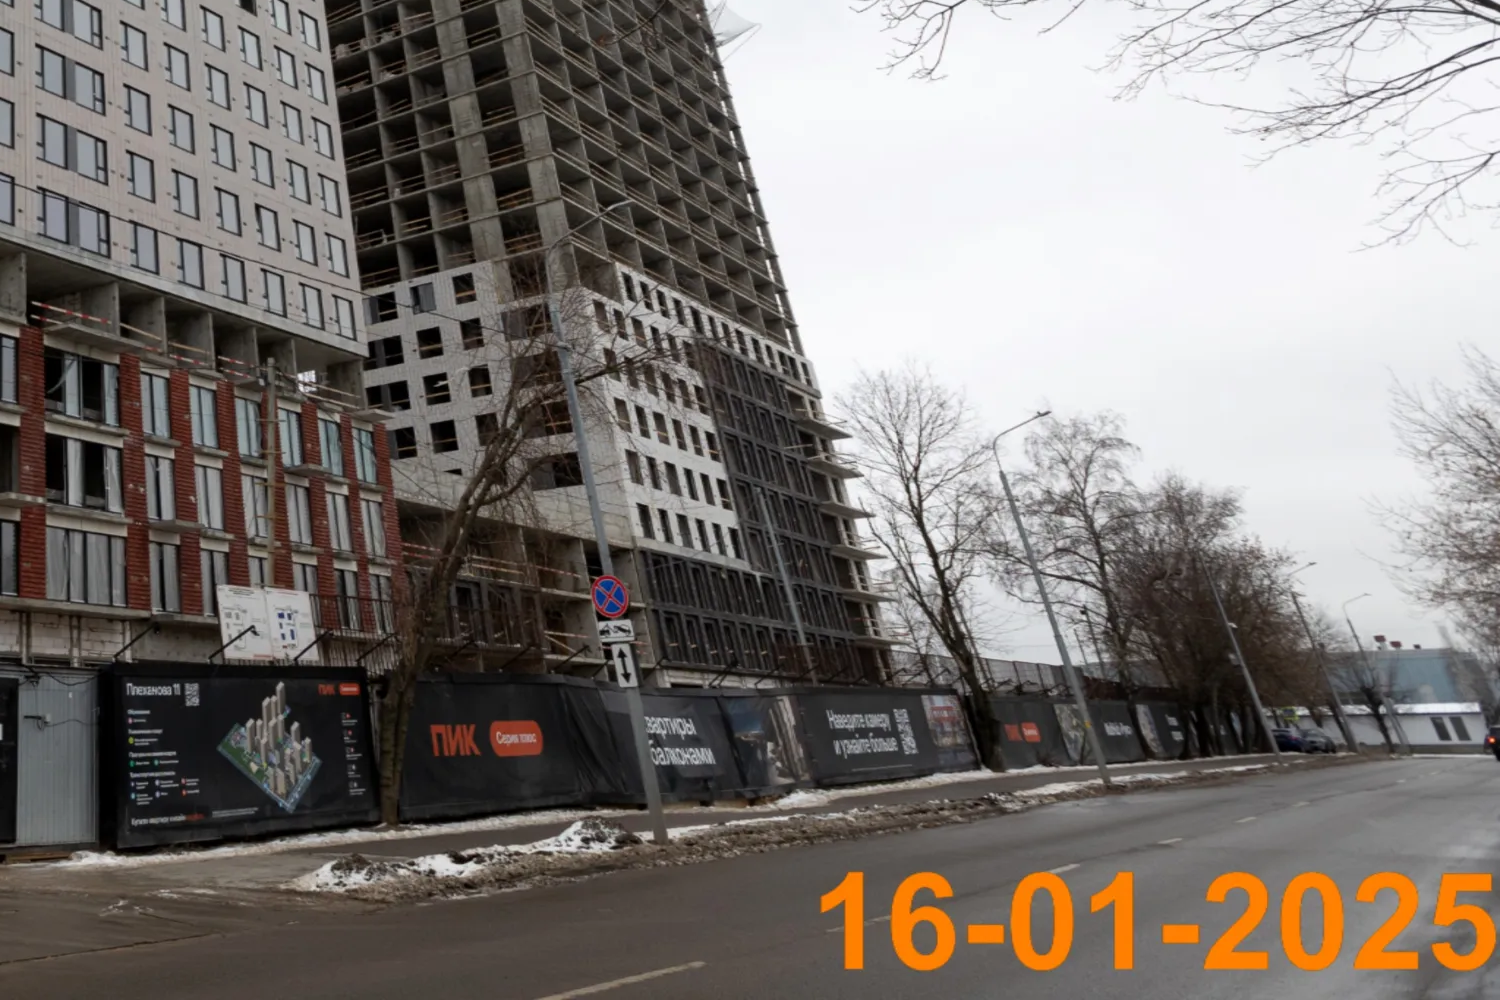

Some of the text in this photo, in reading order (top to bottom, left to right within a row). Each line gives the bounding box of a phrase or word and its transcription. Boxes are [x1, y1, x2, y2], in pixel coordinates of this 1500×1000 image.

[126, 682, 181, 696] Плеханова 11
[430, 723, 481, 757] ПИК
[644, 716, 697, 740] вартиры
[648, 739, 716, 766] балконами
